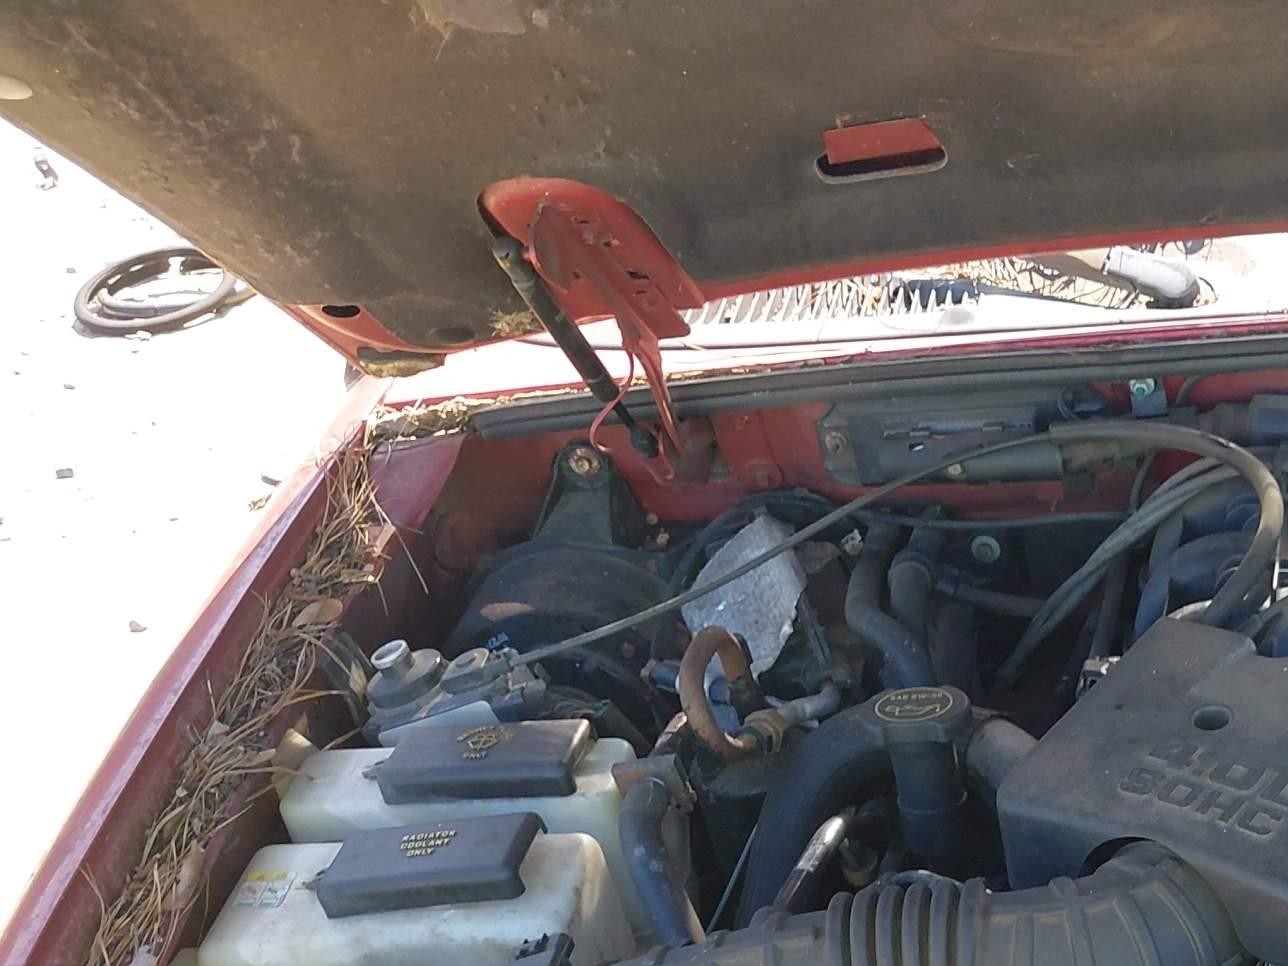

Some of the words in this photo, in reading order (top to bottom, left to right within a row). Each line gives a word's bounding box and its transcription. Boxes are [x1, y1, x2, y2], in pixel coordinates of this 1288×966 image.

[1118, 766, 1286, 836] SOHC
[402, 829, 456, 842] RADIATOR
[400, 838, 449, 849] COOLANT
[406, 847, 434, 857] ONLY
